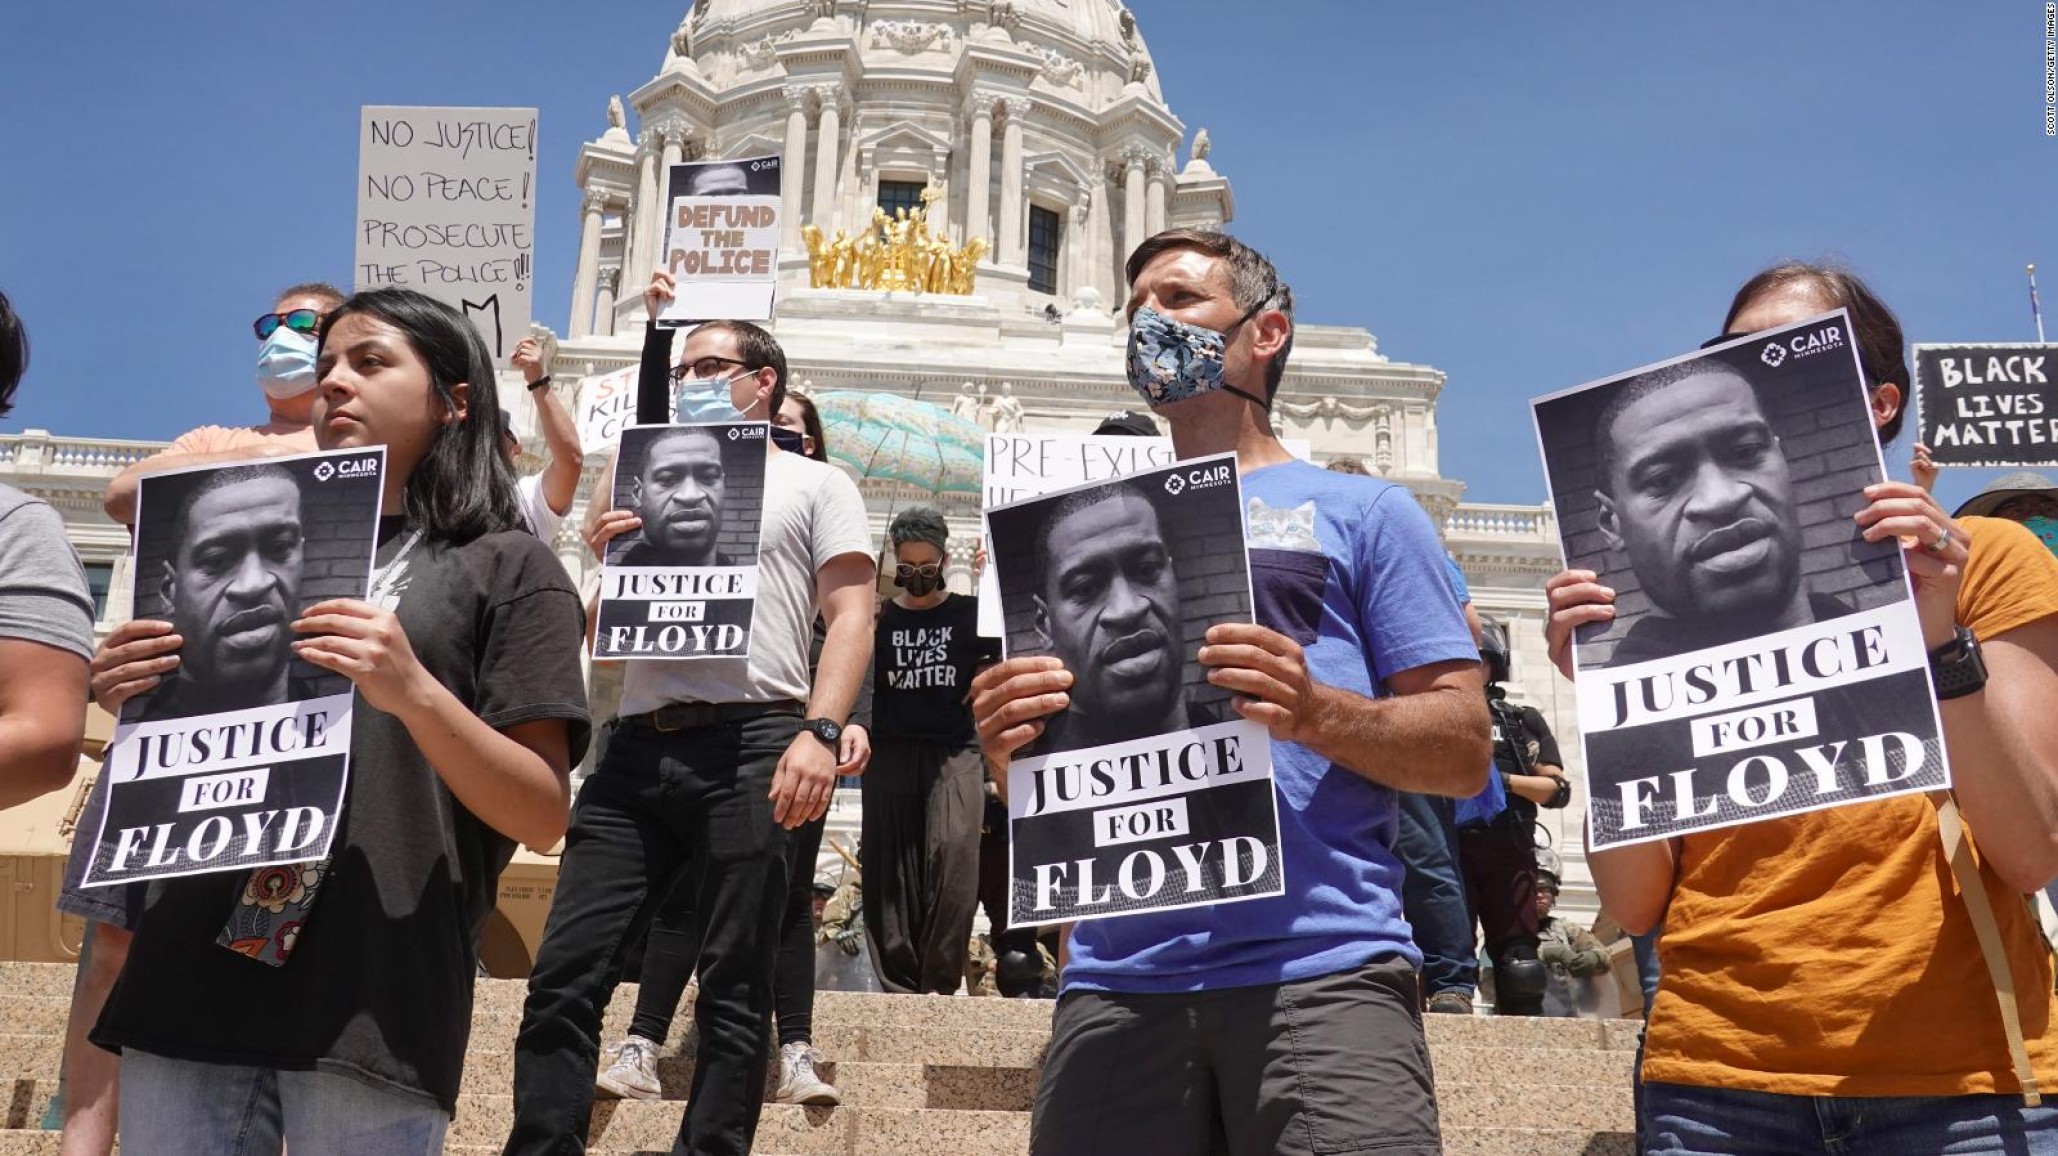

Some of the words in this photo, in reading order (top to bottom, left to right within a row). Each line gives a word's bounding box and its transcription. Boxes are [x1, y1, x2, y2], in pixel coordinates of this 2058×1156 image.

[371, 120, 414, 148] NO
[424, 118, 536, 161] JUSTICE!
[368, 174, 414, 202] NO
[678, 204, 776, 228] DEFUND
[363, 219, 531, 249] PROSECUTE
[701, 230, 744, 248] THE
[360, 263, 408, 285] THE
[669, 249, 771, 275] POLICE
[1791, 326, 1842, 352] CAIR
[1794, 341, 1845, 359] MINNESOTA
[1939, 356, 2049, 388] BLACK
[1956, 393, 2044, 418] LIVES
[742, 427, 765, 436] CAIR
[338, 458, 378, 474] CAIR
[1189, 465, 1231, 485] CAIR
[616, 572, 744, 599] JUSTICE
[657, 604, 698, 620] FOR
[606, 623, 744, 653] FLOYD
[892, 626, 953, 648] BLACK
[896, 644, 948, 668] LIVES
[888, 665, 957, 690] MATTER
[1609, 623, 1891, 729] JUSTICE
[1708, 709, 1800, 748] FOR
[133, 710, 329, 781] JUSTICE
[1032, 734, 1245, 816] JUSTICE
[1615, 730, 1926, 833] FLOYD
[194, 776, 256, 806] FOR
[1107, 805, 1178, 840] FOR
[106, 805, 326, 873] FLOYD
[1032, 834, 1269, 912] FLOYD
